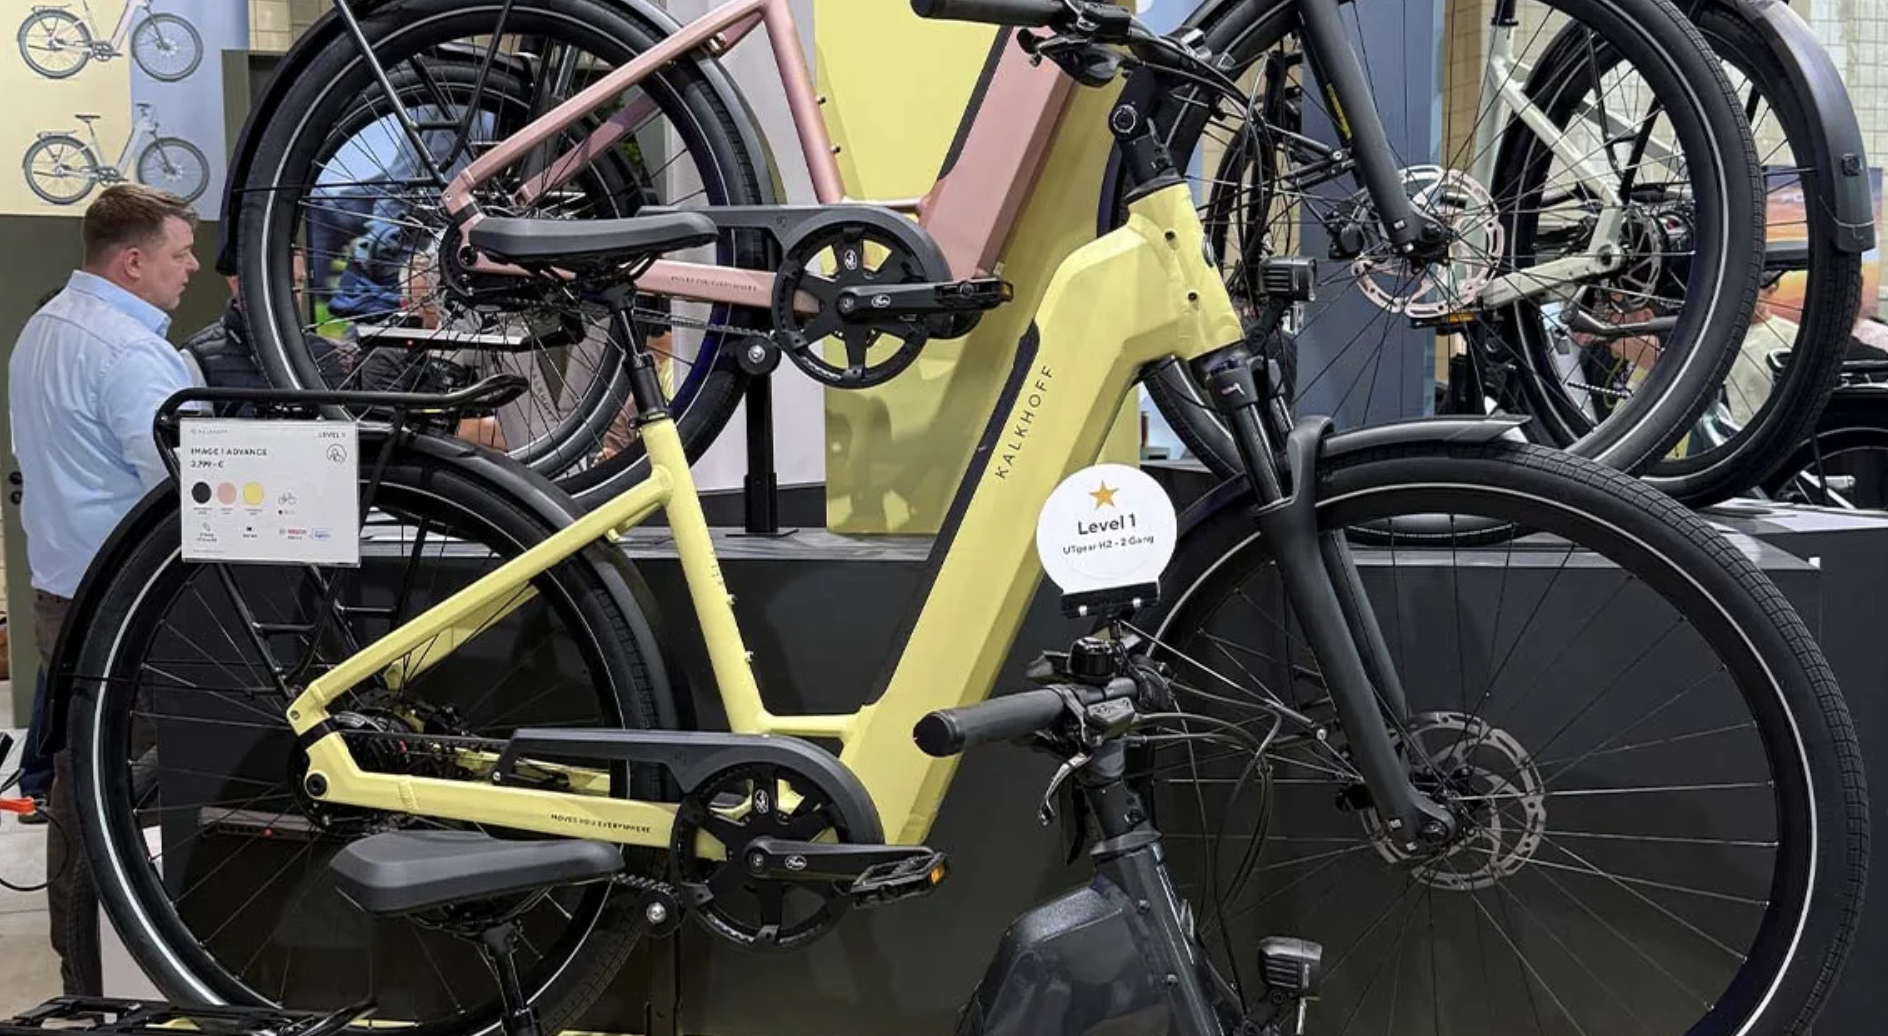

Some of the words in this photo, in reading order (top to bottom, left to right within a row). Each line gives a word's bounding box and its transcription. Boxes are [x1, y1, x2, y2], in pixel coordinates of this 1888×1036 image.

[995, 365, 1053, 479] KALKHOFF
[191, 446, 219, 456] IMAGE
[226, 448, 268, 457] ADVANCE
[1078, 515, 1124, 535] Level
[1128, 513, 1137, 527] 1
[1062, 543, 1096, 555] UTgear
[1099, 540, 1113, 550] H2
[1121, 539, 1128, 547] 2
[1128, 535, 1154, 546] Gang
[551, 813, 578, 824] MOVES
[598, 820, 651, 833] EVERYWHERE
